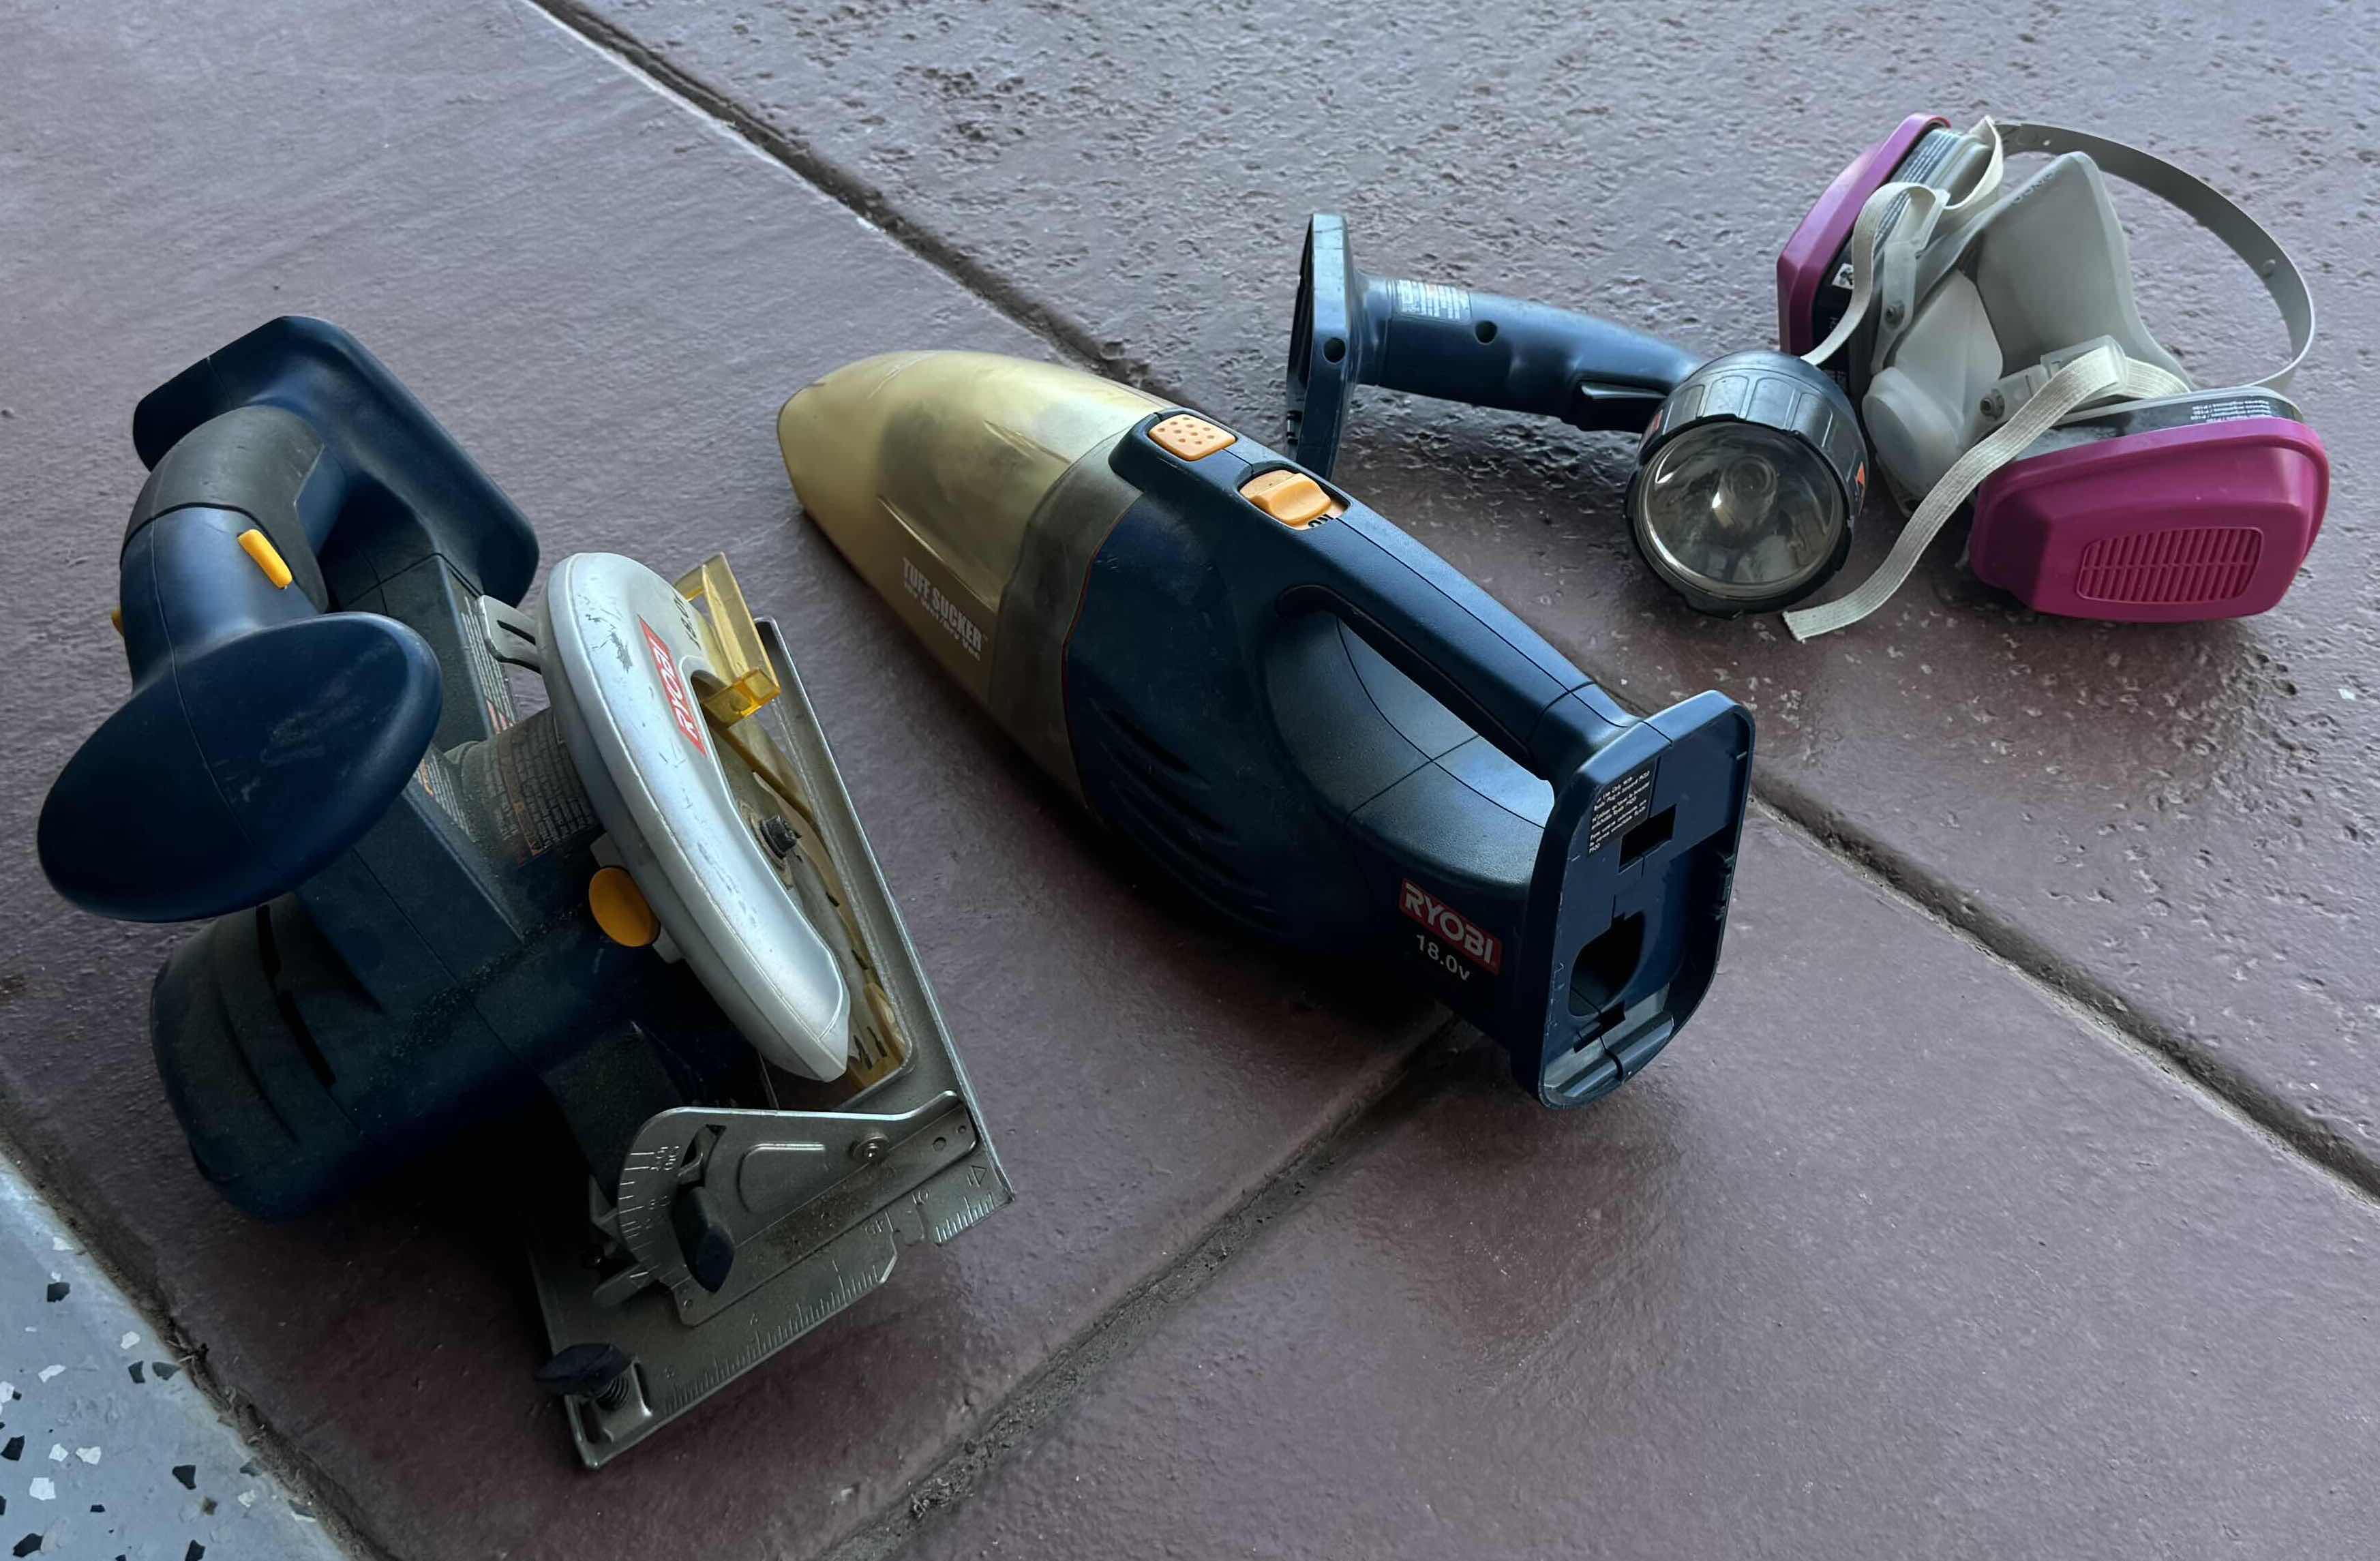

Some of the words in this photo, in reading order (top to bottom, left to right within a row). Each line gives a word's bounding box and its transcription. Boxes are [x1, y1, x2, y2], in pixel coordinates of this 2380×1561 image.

[932, 587, 982, 652] SUCKER
[647, 634, 699, 743] RYOBI
[1405, 881, 1494, 964] RYOBI
